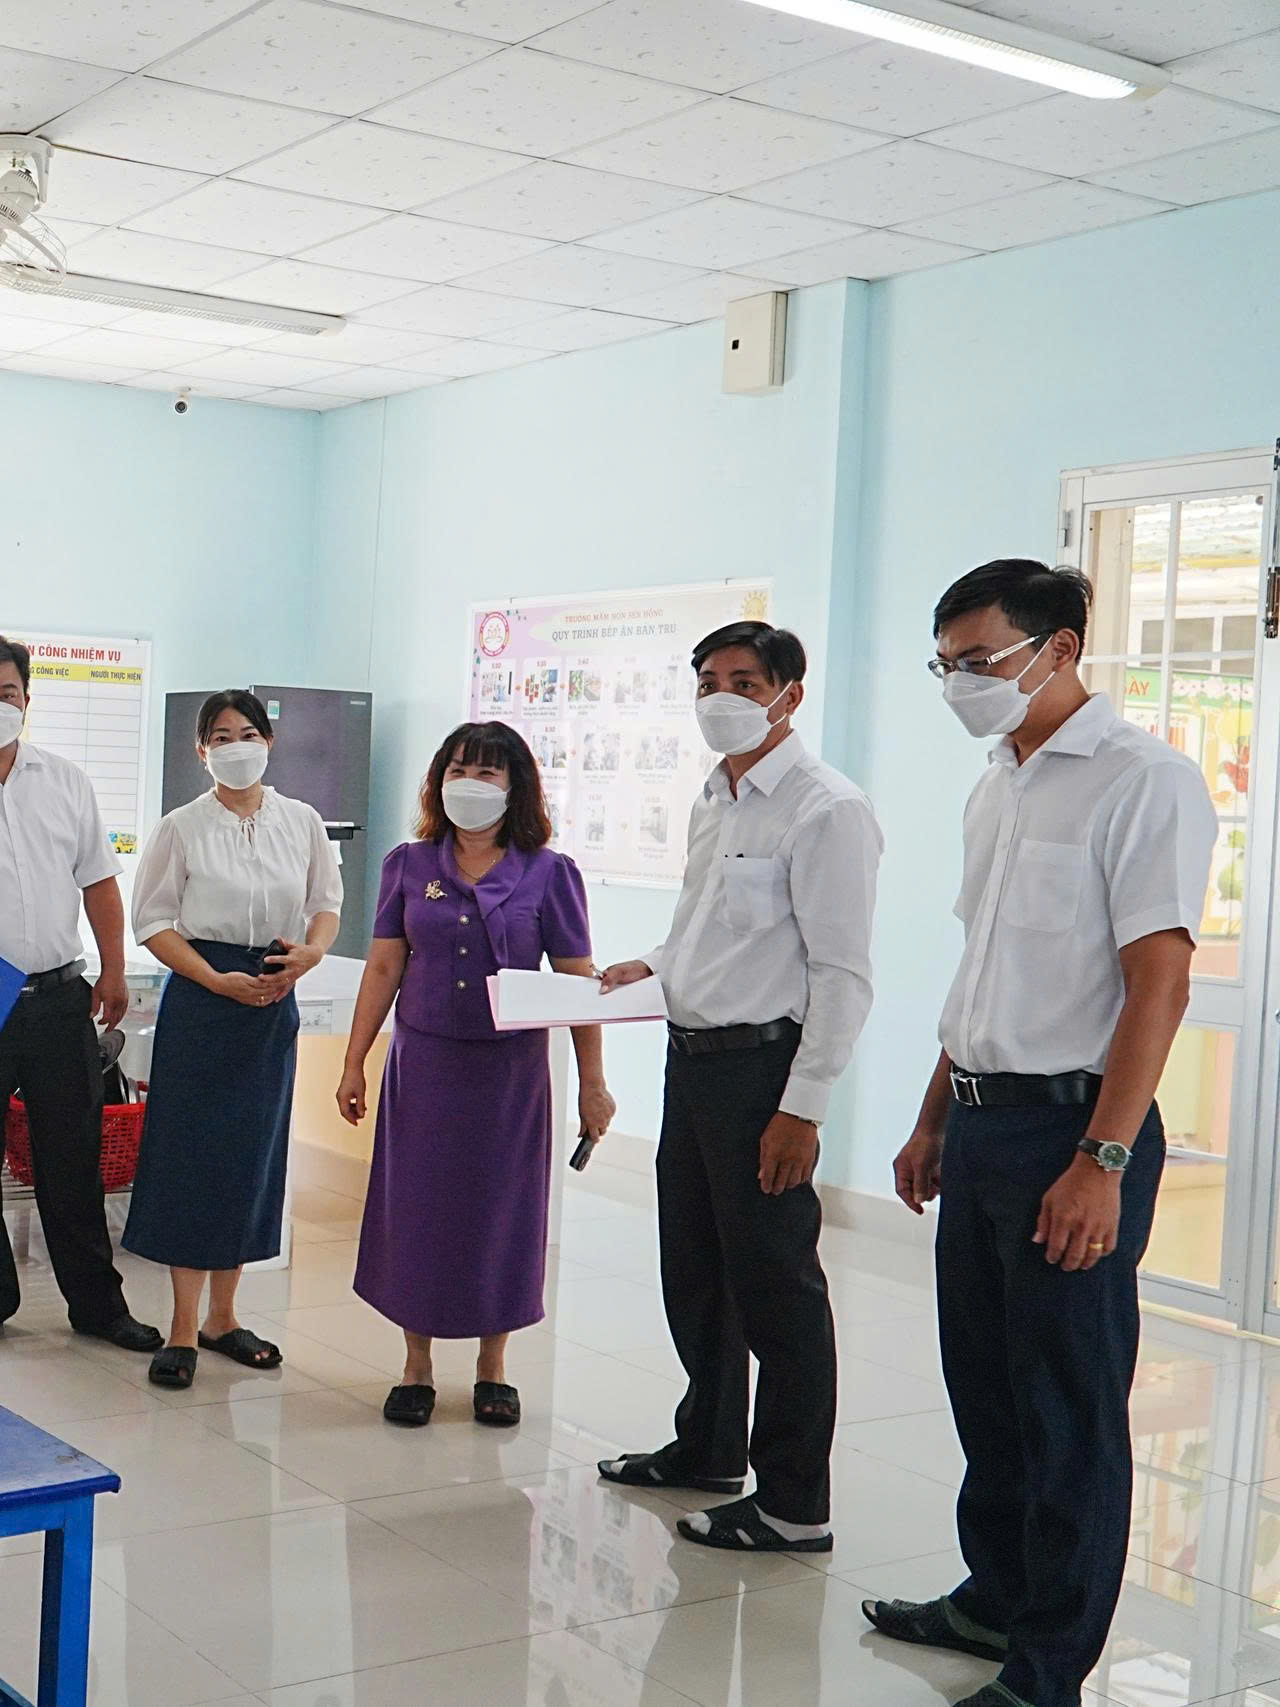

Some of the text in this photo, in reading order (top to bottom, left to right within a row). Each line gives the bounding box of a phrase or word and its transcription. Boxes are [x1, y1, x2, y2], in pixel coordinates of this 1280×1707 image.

[552, 630, 570, 642] QUY
[38, 644, 67, 658] CÔNG
[70, 647, 105, 662] NHIỆM
[107, 650, 121, 664] VỤ
[36, 665, 53, 676] CÔNG
[55, 667, 69, 677] VIỆC
[1125, 675, 1150, 696] ÀY
